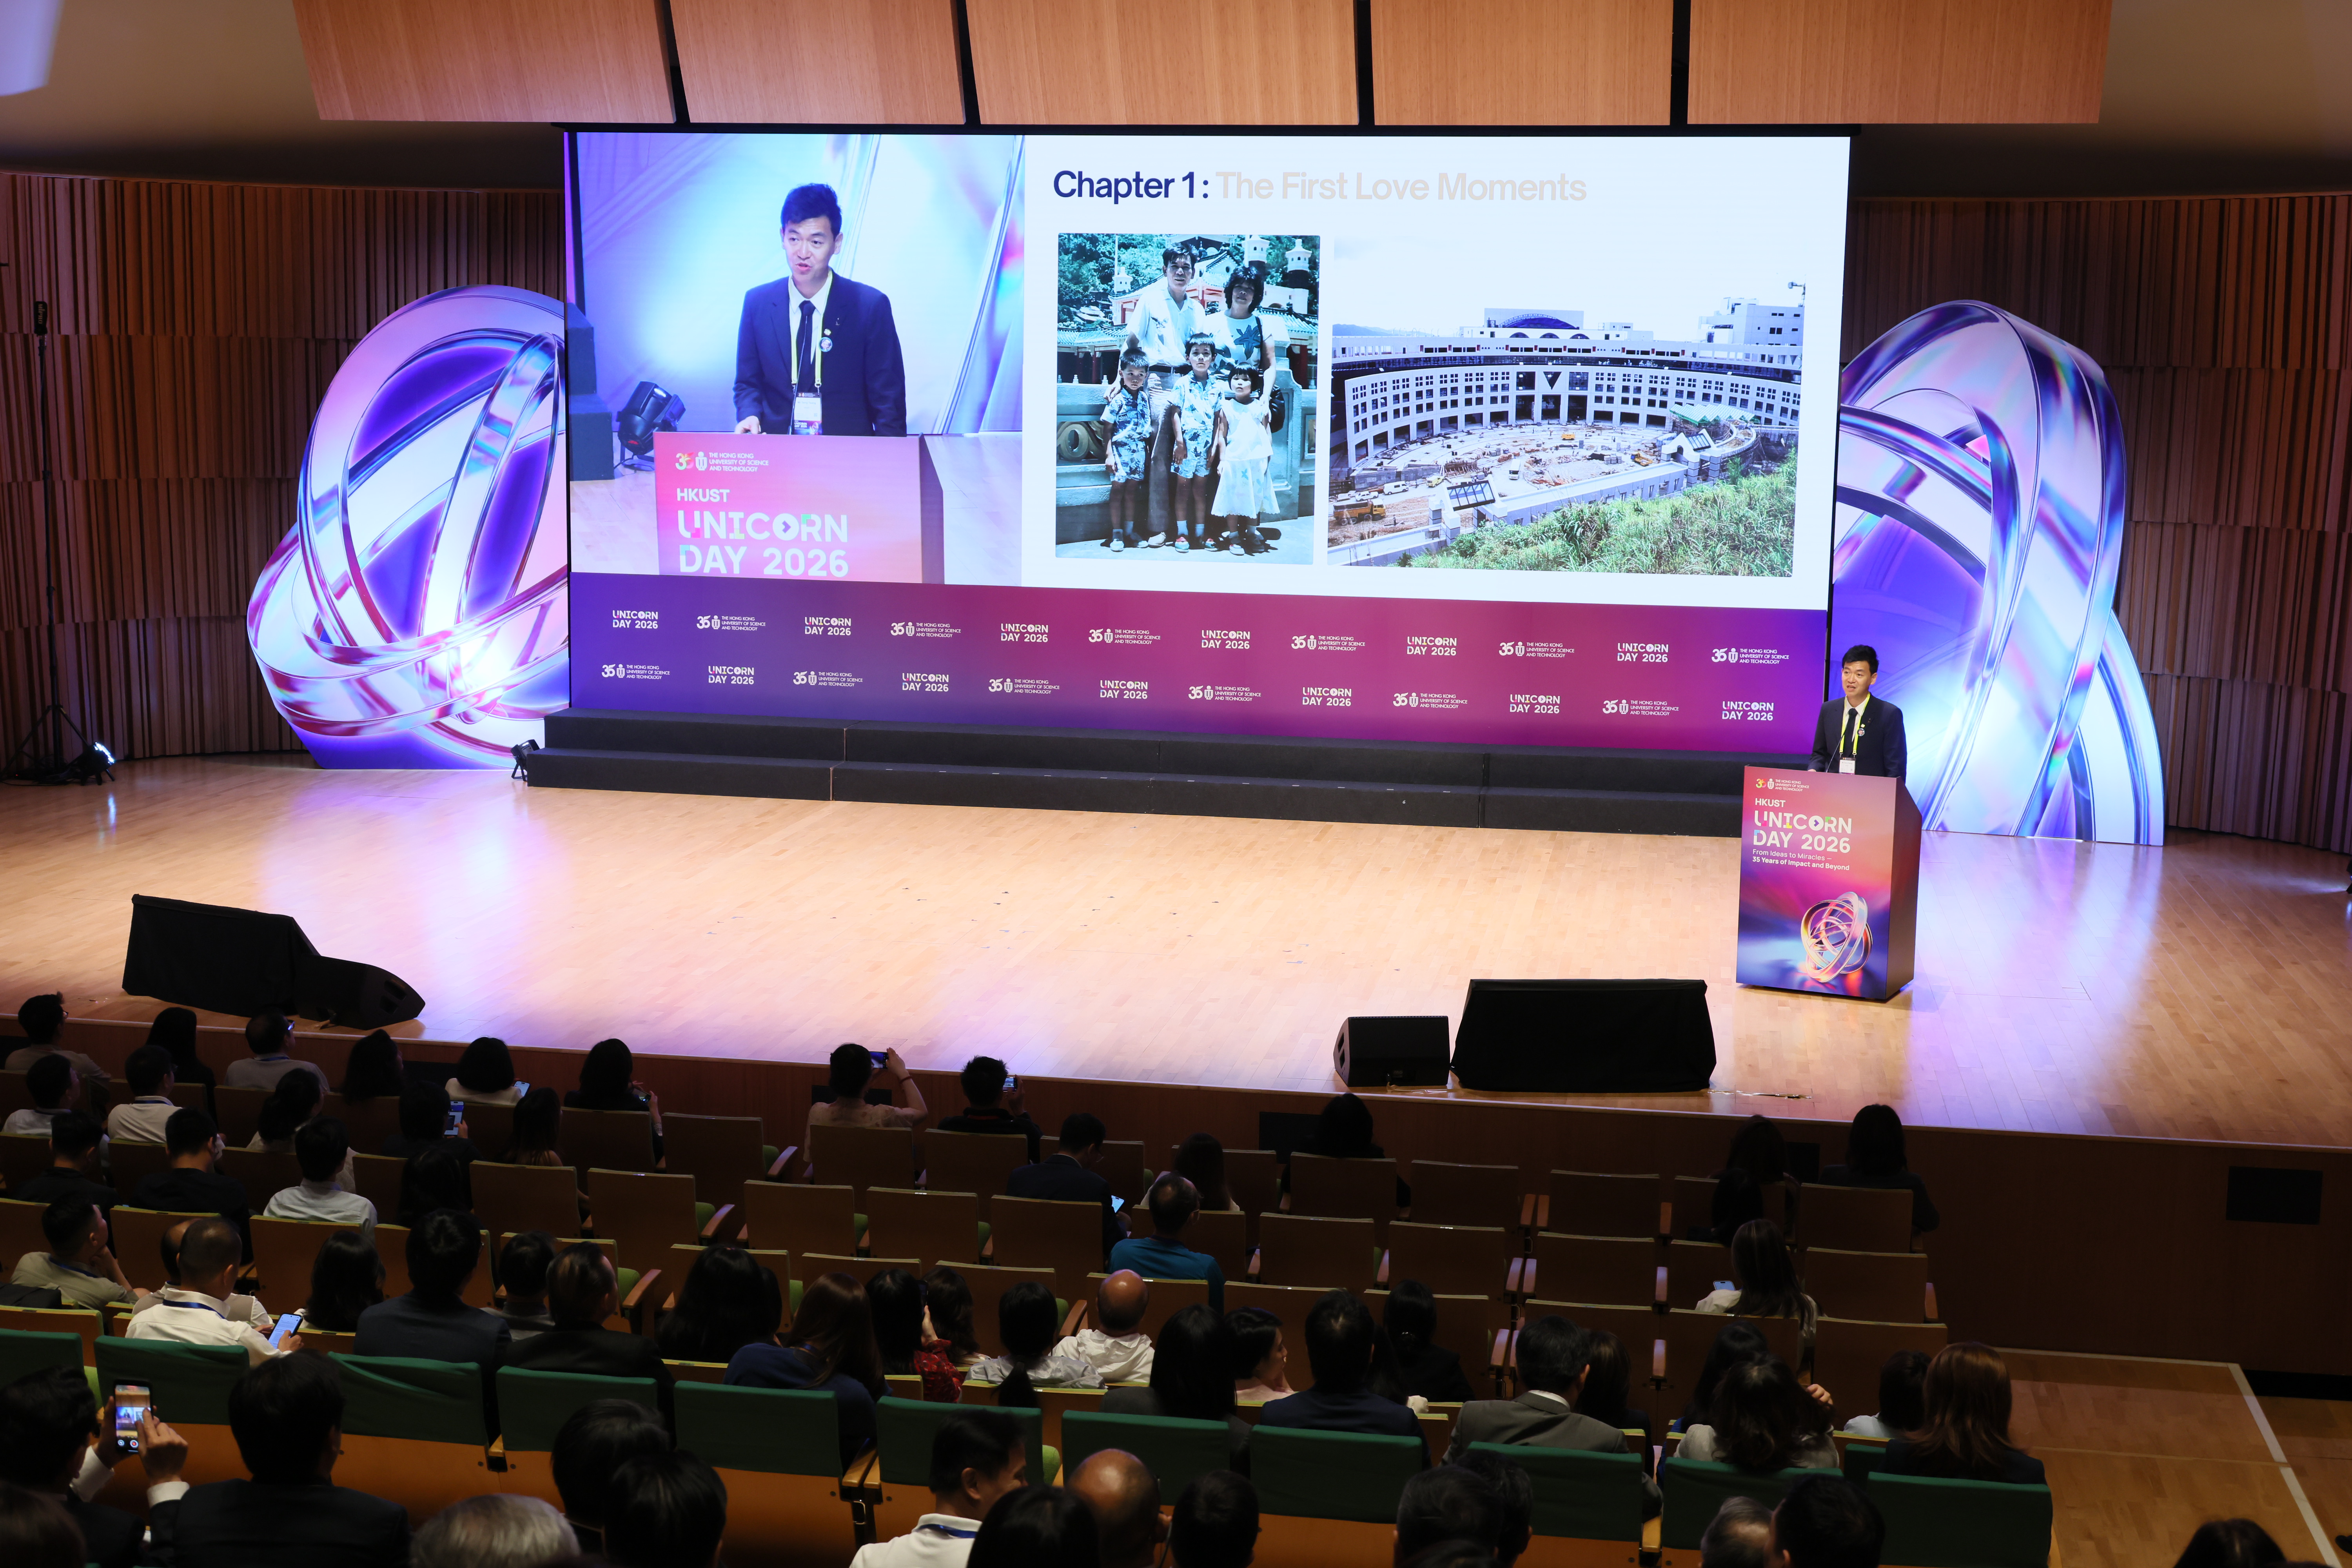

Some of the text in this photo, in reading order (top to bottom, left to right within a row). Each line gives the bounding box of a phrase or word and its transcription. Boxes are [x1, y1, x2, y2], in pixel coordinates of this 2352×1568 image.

[1054, 170, 1587, 204] Chapter 1: The First Love Moments
[677, 488, 730, 502] HKUST
[678, 510, 849, 543] UNICORN
[679, 544, 849, 577] DAY 2026
[613, 610, 658, 620] UNICORN
[613, 619, 658, 629] DAY 2026
[805, 617, 851, 626] UNICORN
[805, 626, 851, 636] DAY 2026
[1001, 623, 1048, 633] UNICORN
[1001, 633, 1048, 642] DAY 2026
[1407, 636, 1457, 646] UNICORN
[1407, 646, 1456, 656] DAY 2026
[1618, 643, 1668, 653] UNICORN
[1617, 653, 1668, 662] DAY 2026
[708, 666, 754, 675] UNICORN
[708, 675, 754, 684] DAY 2026
[902, 673, 949, 682] UNICORN
[902, 682, 949, 692] DAY 2026
[1303, 687, 1352, 697] UNICORN
[1302, 697, 1351, 706] DAY 2026
[1510, 694, 1560, 704] UNICORN
[1510, 704, 1560, 714] DAY 2026
[1722, 701, 1774, 711] UNICORN
[1722, 711, 1773, 721] DAY 2026
[1755, 798, 1786, 808] HKUST
[1754, 810, 1852, 834] UNICORN
[1753, 829, 1851, 853] DAY 2026
